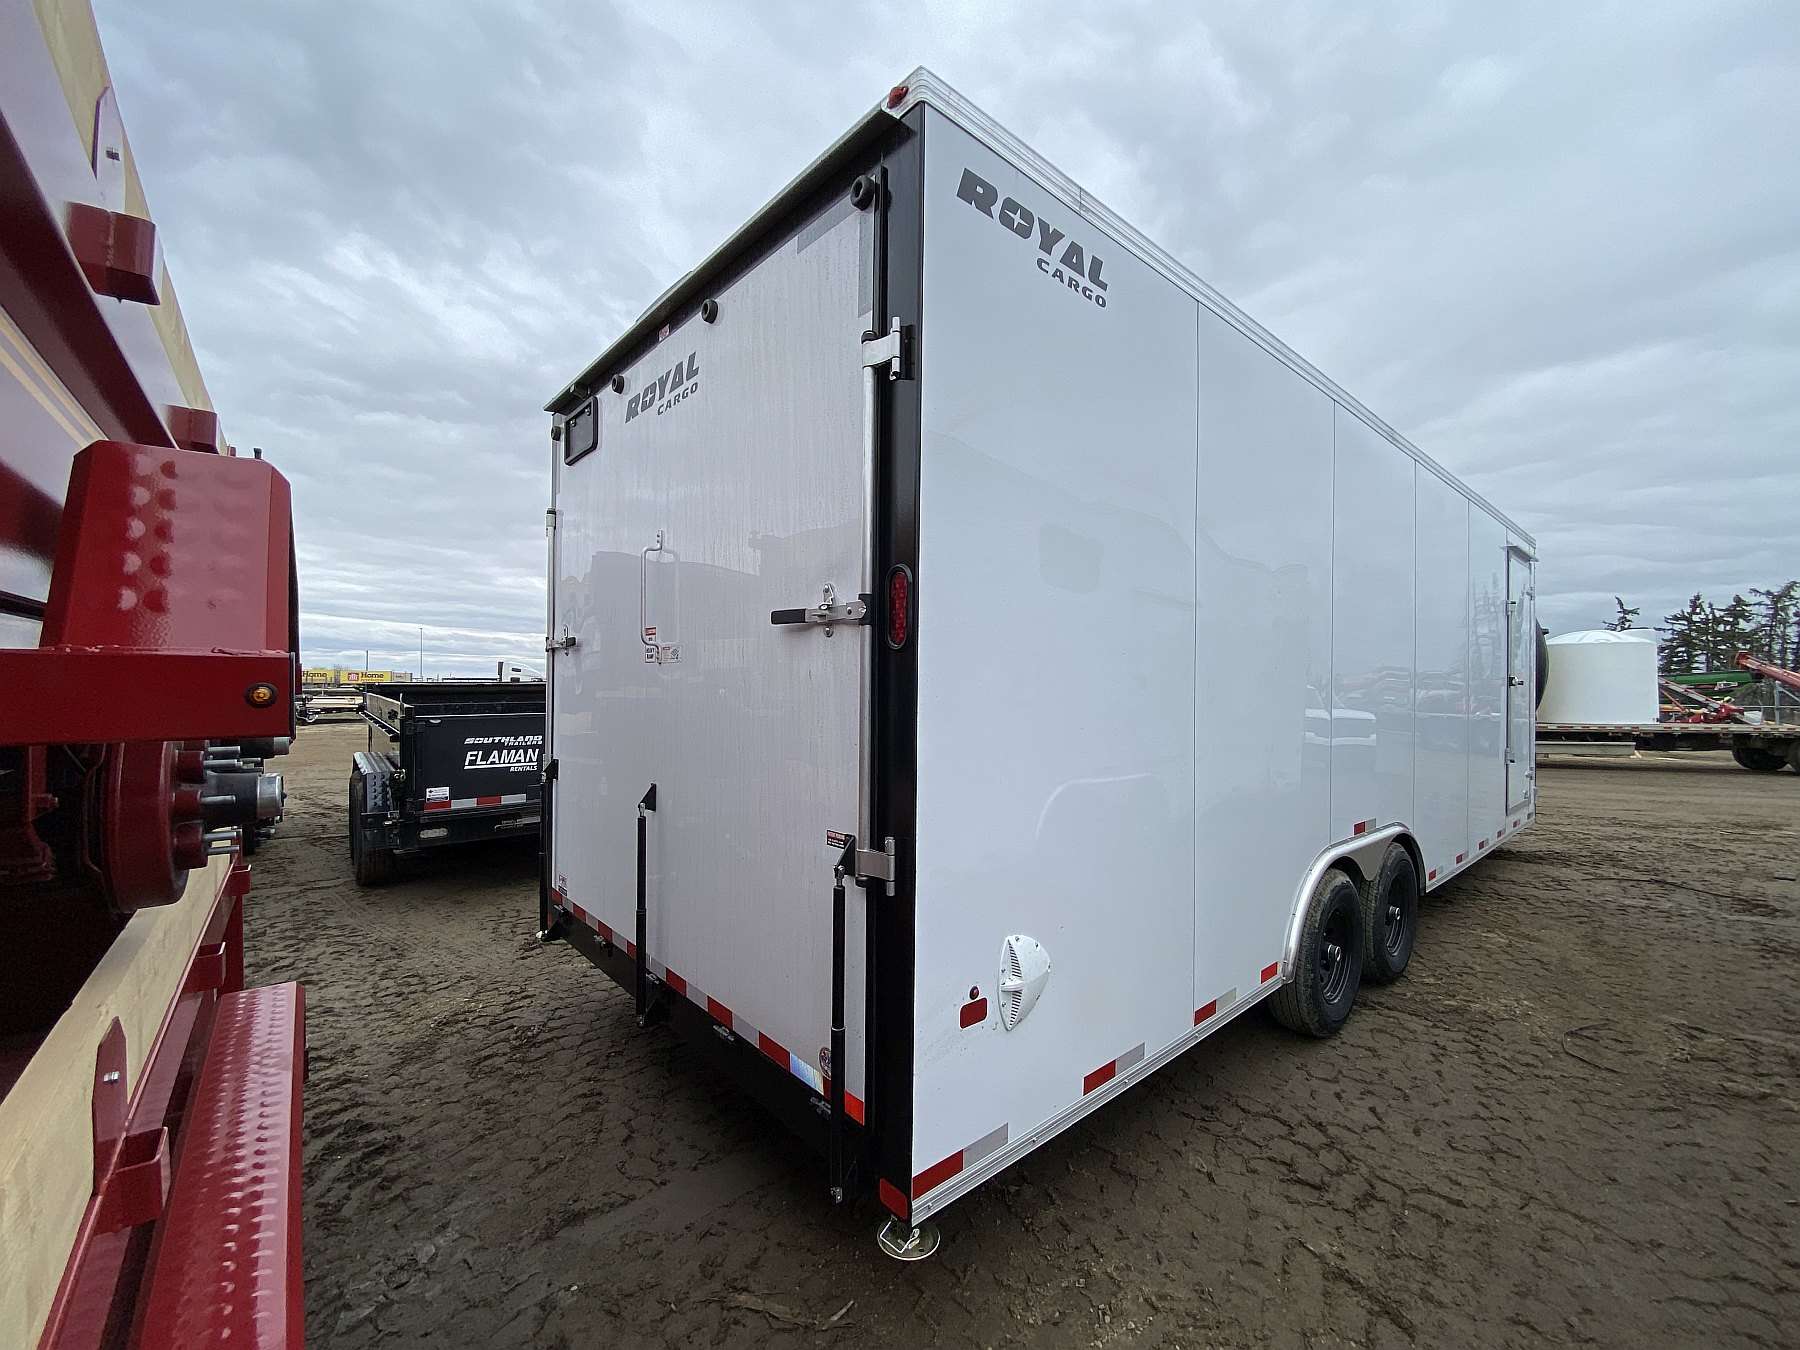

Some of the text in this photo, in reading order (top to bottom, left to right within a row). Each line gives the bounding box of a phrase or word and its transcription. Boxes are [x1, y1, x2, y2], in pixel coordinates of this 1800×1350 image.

[957, 168, 1108, 292] ROYAL
[1036, 257, 1107, 309] CARGO
[625, 351, 700, 424] ROYAL
[657, 382, 699, 416] CARGO
[361, 671, 384, 679] Home
[464, 735, 542, 744] SOUTHLAND
[464, 749, 539, 765] FLAMAN
